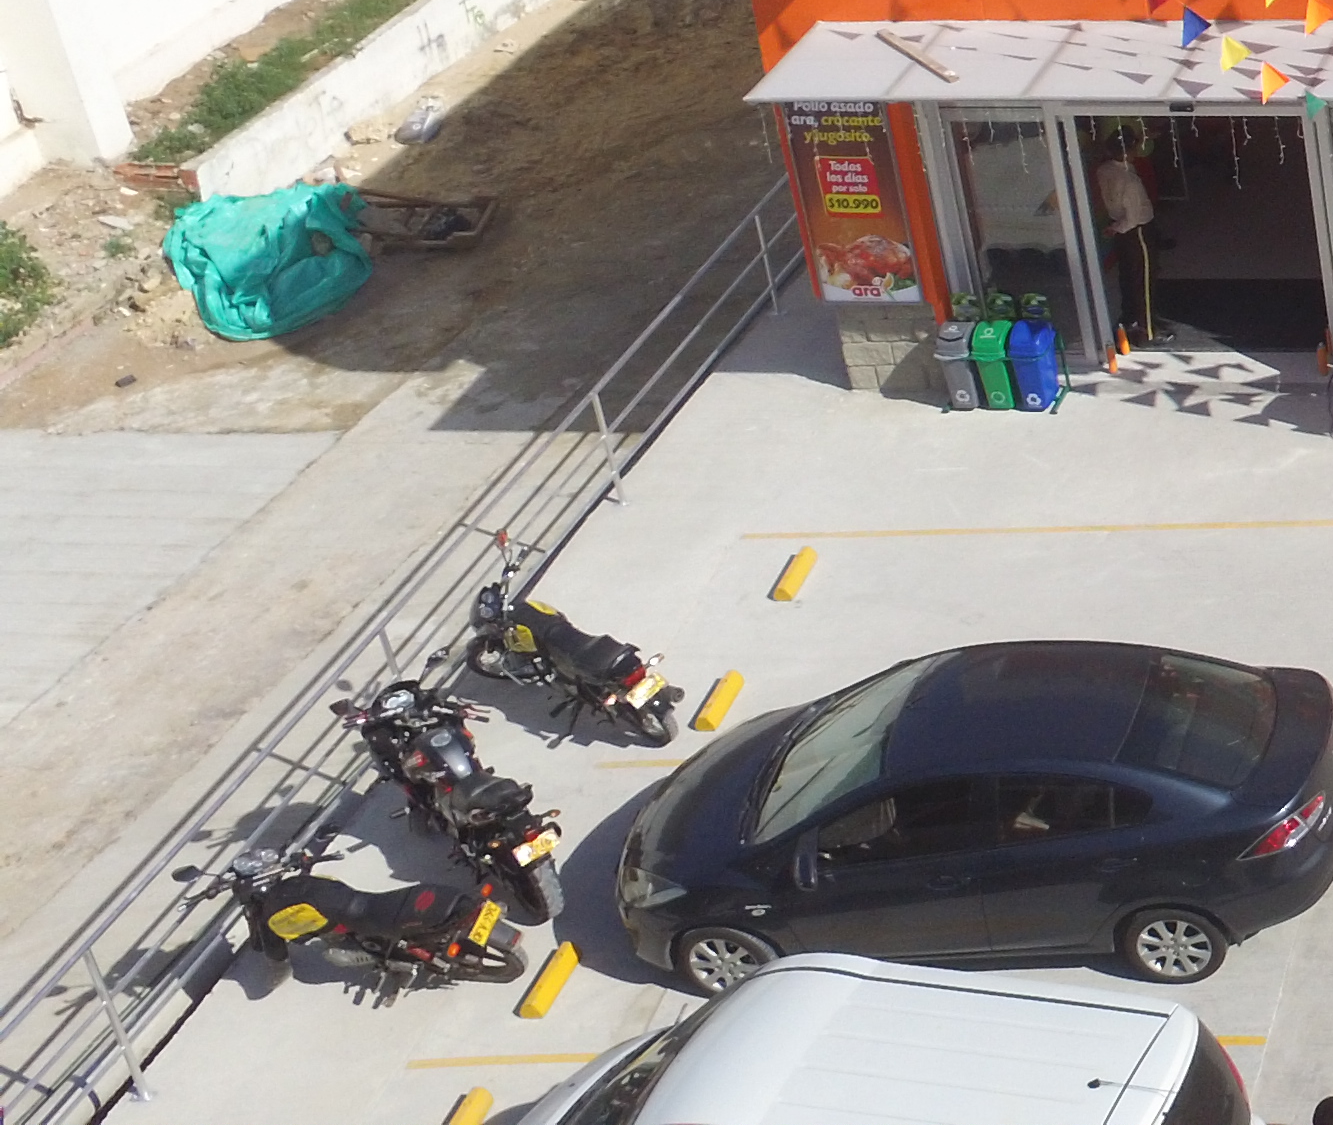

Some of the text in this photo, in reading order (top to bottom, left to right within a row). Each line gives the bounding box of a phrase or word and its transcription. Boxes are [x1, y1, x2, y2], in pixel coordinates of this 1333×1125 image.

[830, 102, 874, 112] asado
[828, 198, 879, 209] $10.990
[852, 287, 881, 297] ara
